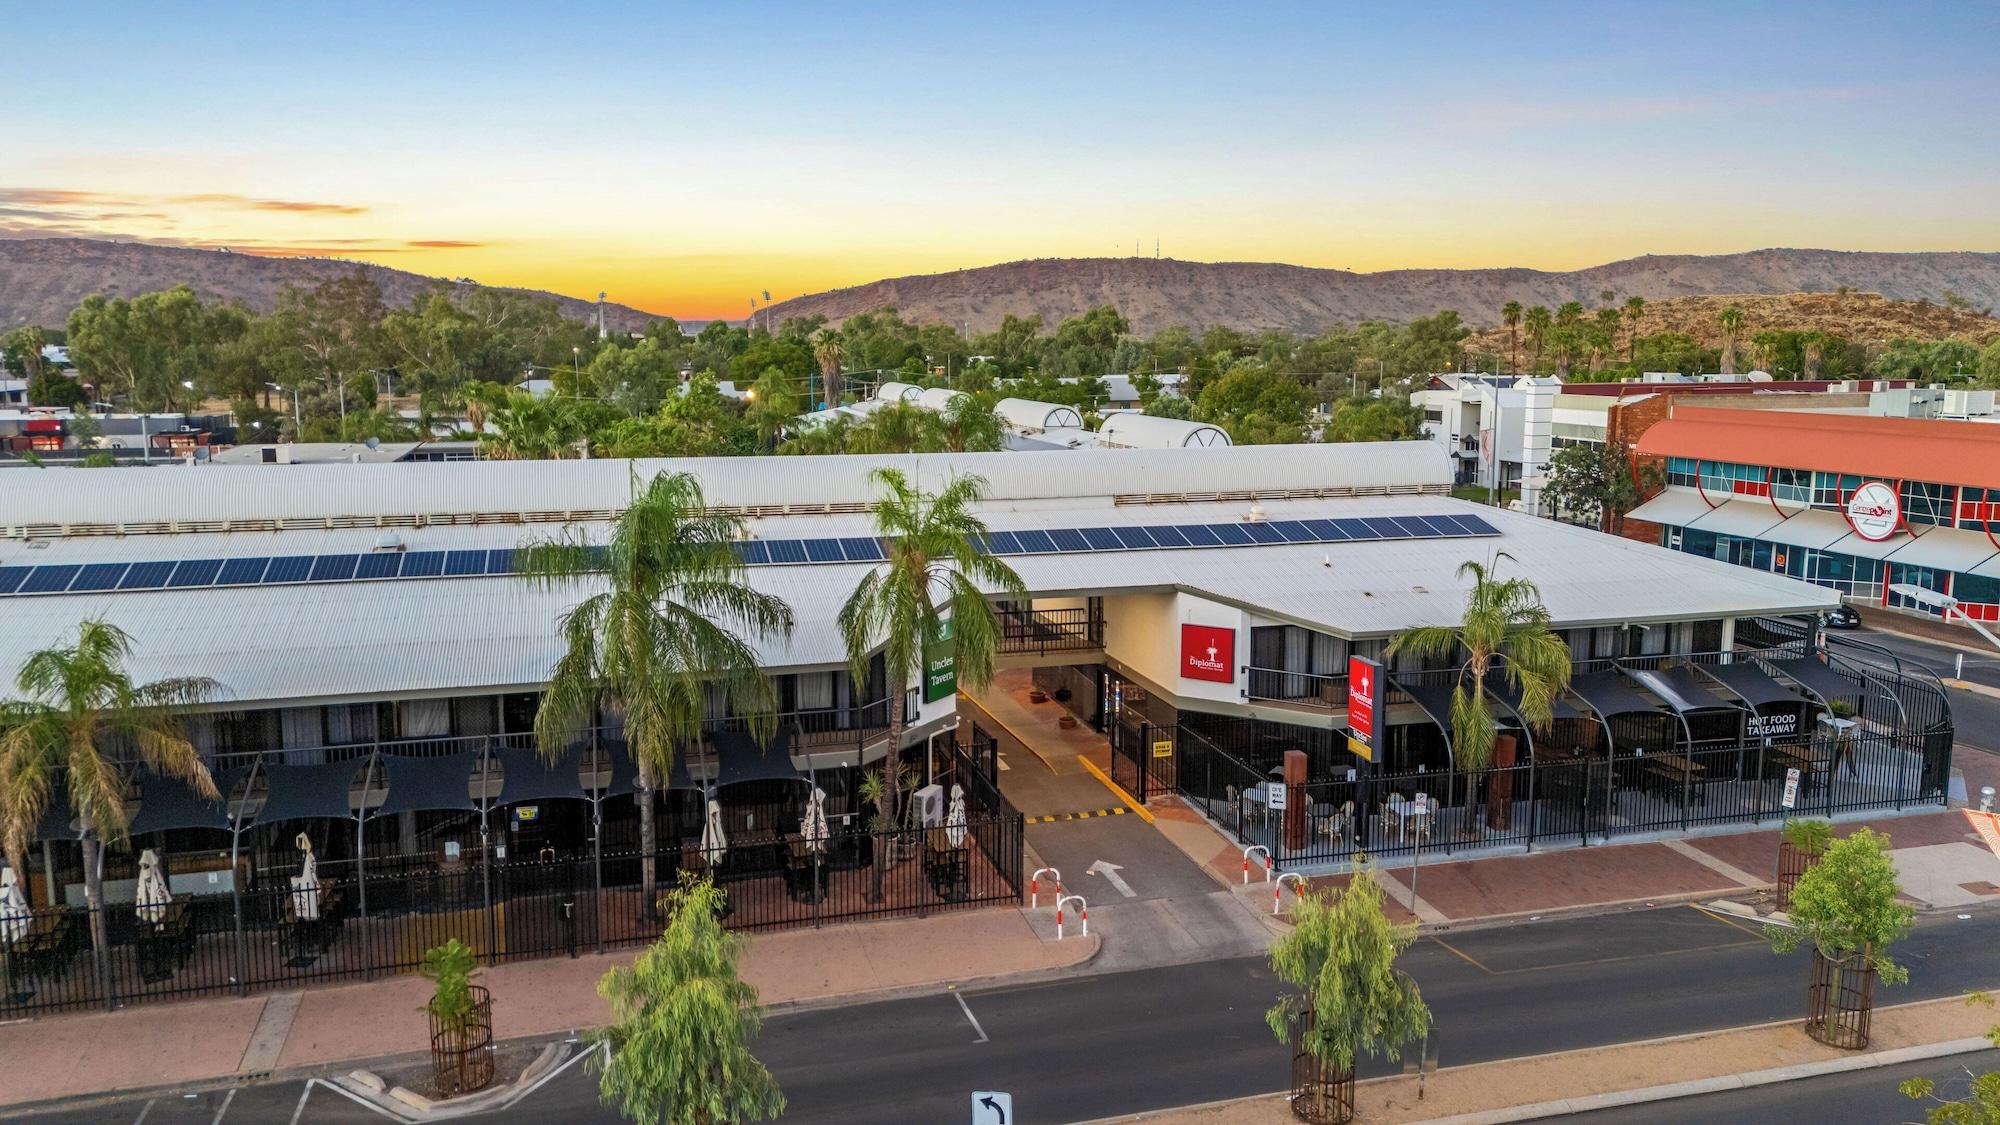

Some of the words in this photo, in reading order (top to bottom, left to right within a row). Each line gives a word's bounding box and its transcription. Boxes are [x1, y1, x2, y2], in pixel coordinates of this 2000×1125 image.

[1852, 503, 1892, 517] Centrepoint
[931, 656, 954, 671] Uncles
[1189, 658, 1224, 669] Diplomat
[931, 671, 954, 686] Tavern
[1350, 687, 1373, 706] Diplomat
[1748, 715, 1769, 726] HOT
[1770, 714, 1796, 725] FOOD
[1746, 723, 1796, 736] TAKEAWAY
